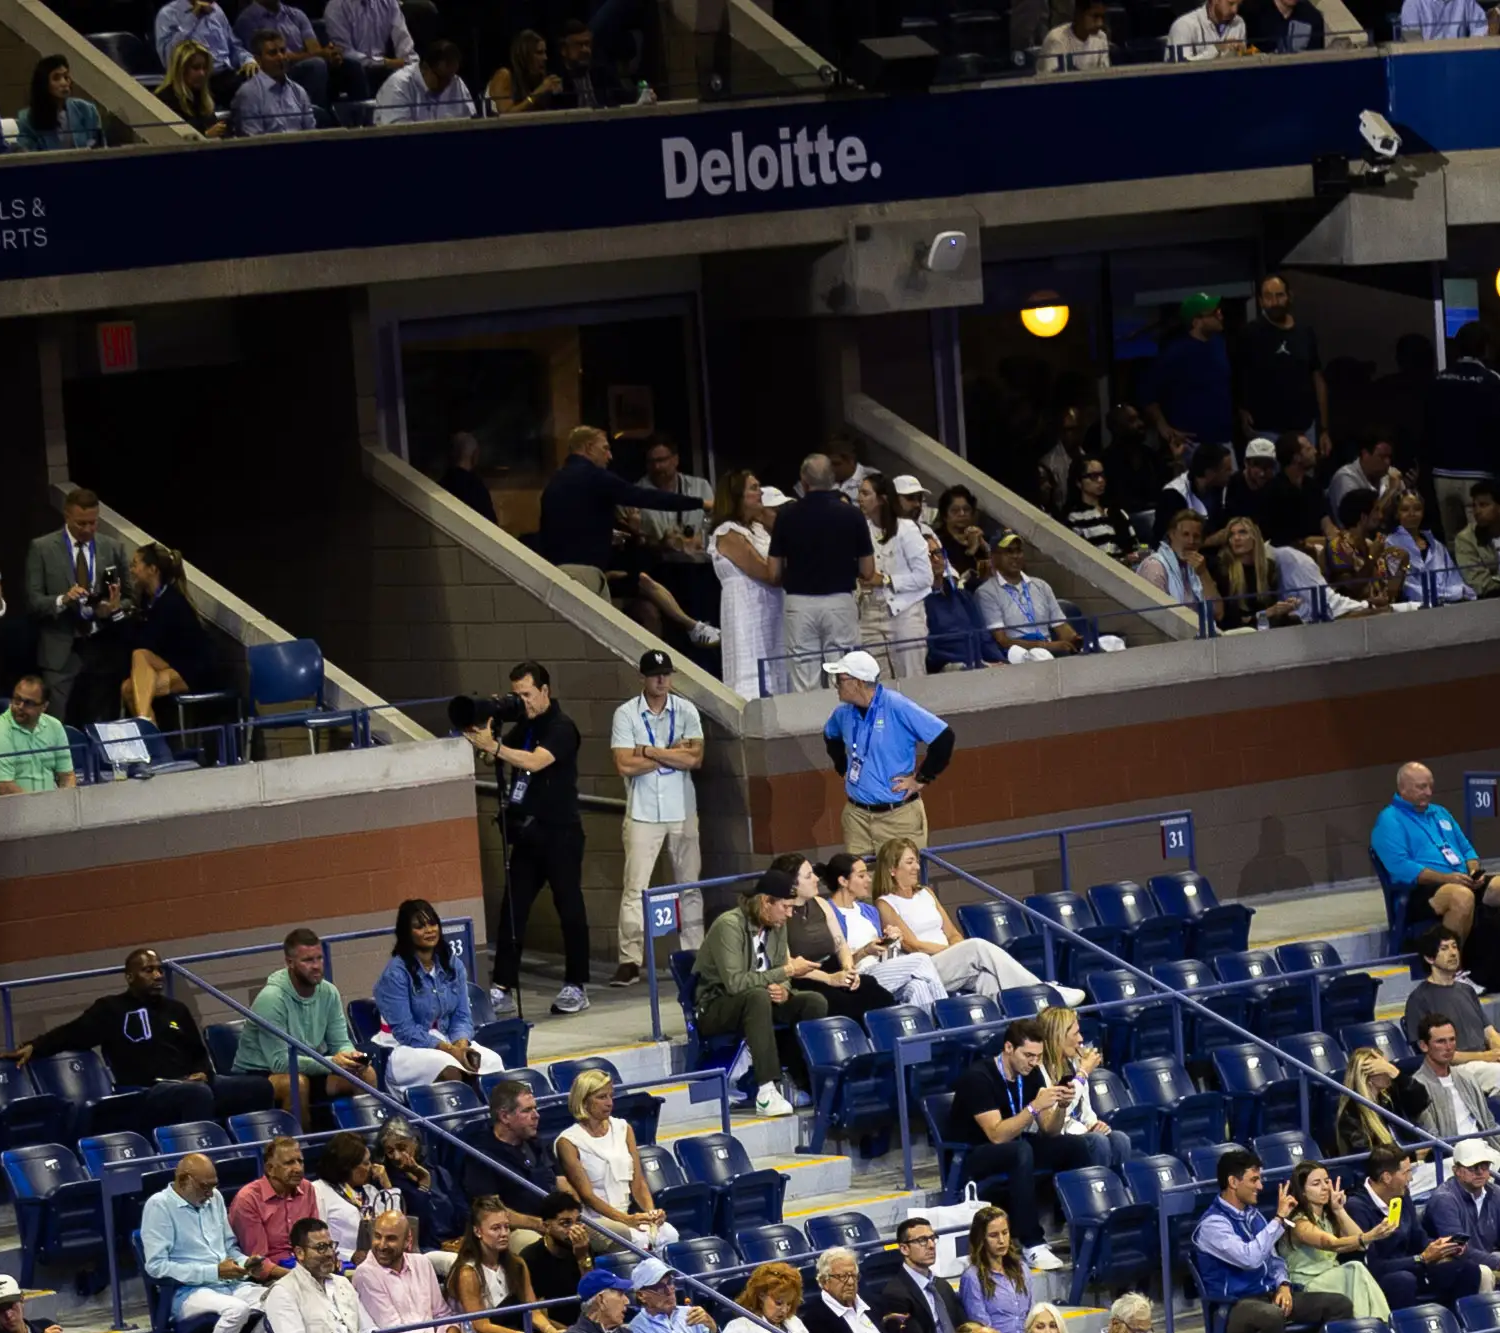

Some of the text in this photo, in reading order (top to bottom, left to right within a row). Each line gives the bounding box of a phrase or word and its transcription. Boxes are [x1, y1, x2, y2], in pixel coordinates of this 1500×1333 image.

[32, 197, 46, 217] &
[102, 326, 132, 366] EXIT
[1475, 791, 1491, 808] 30
[1169, 830, 1184, 849] 31
[655, 907, 672, 927] 32
